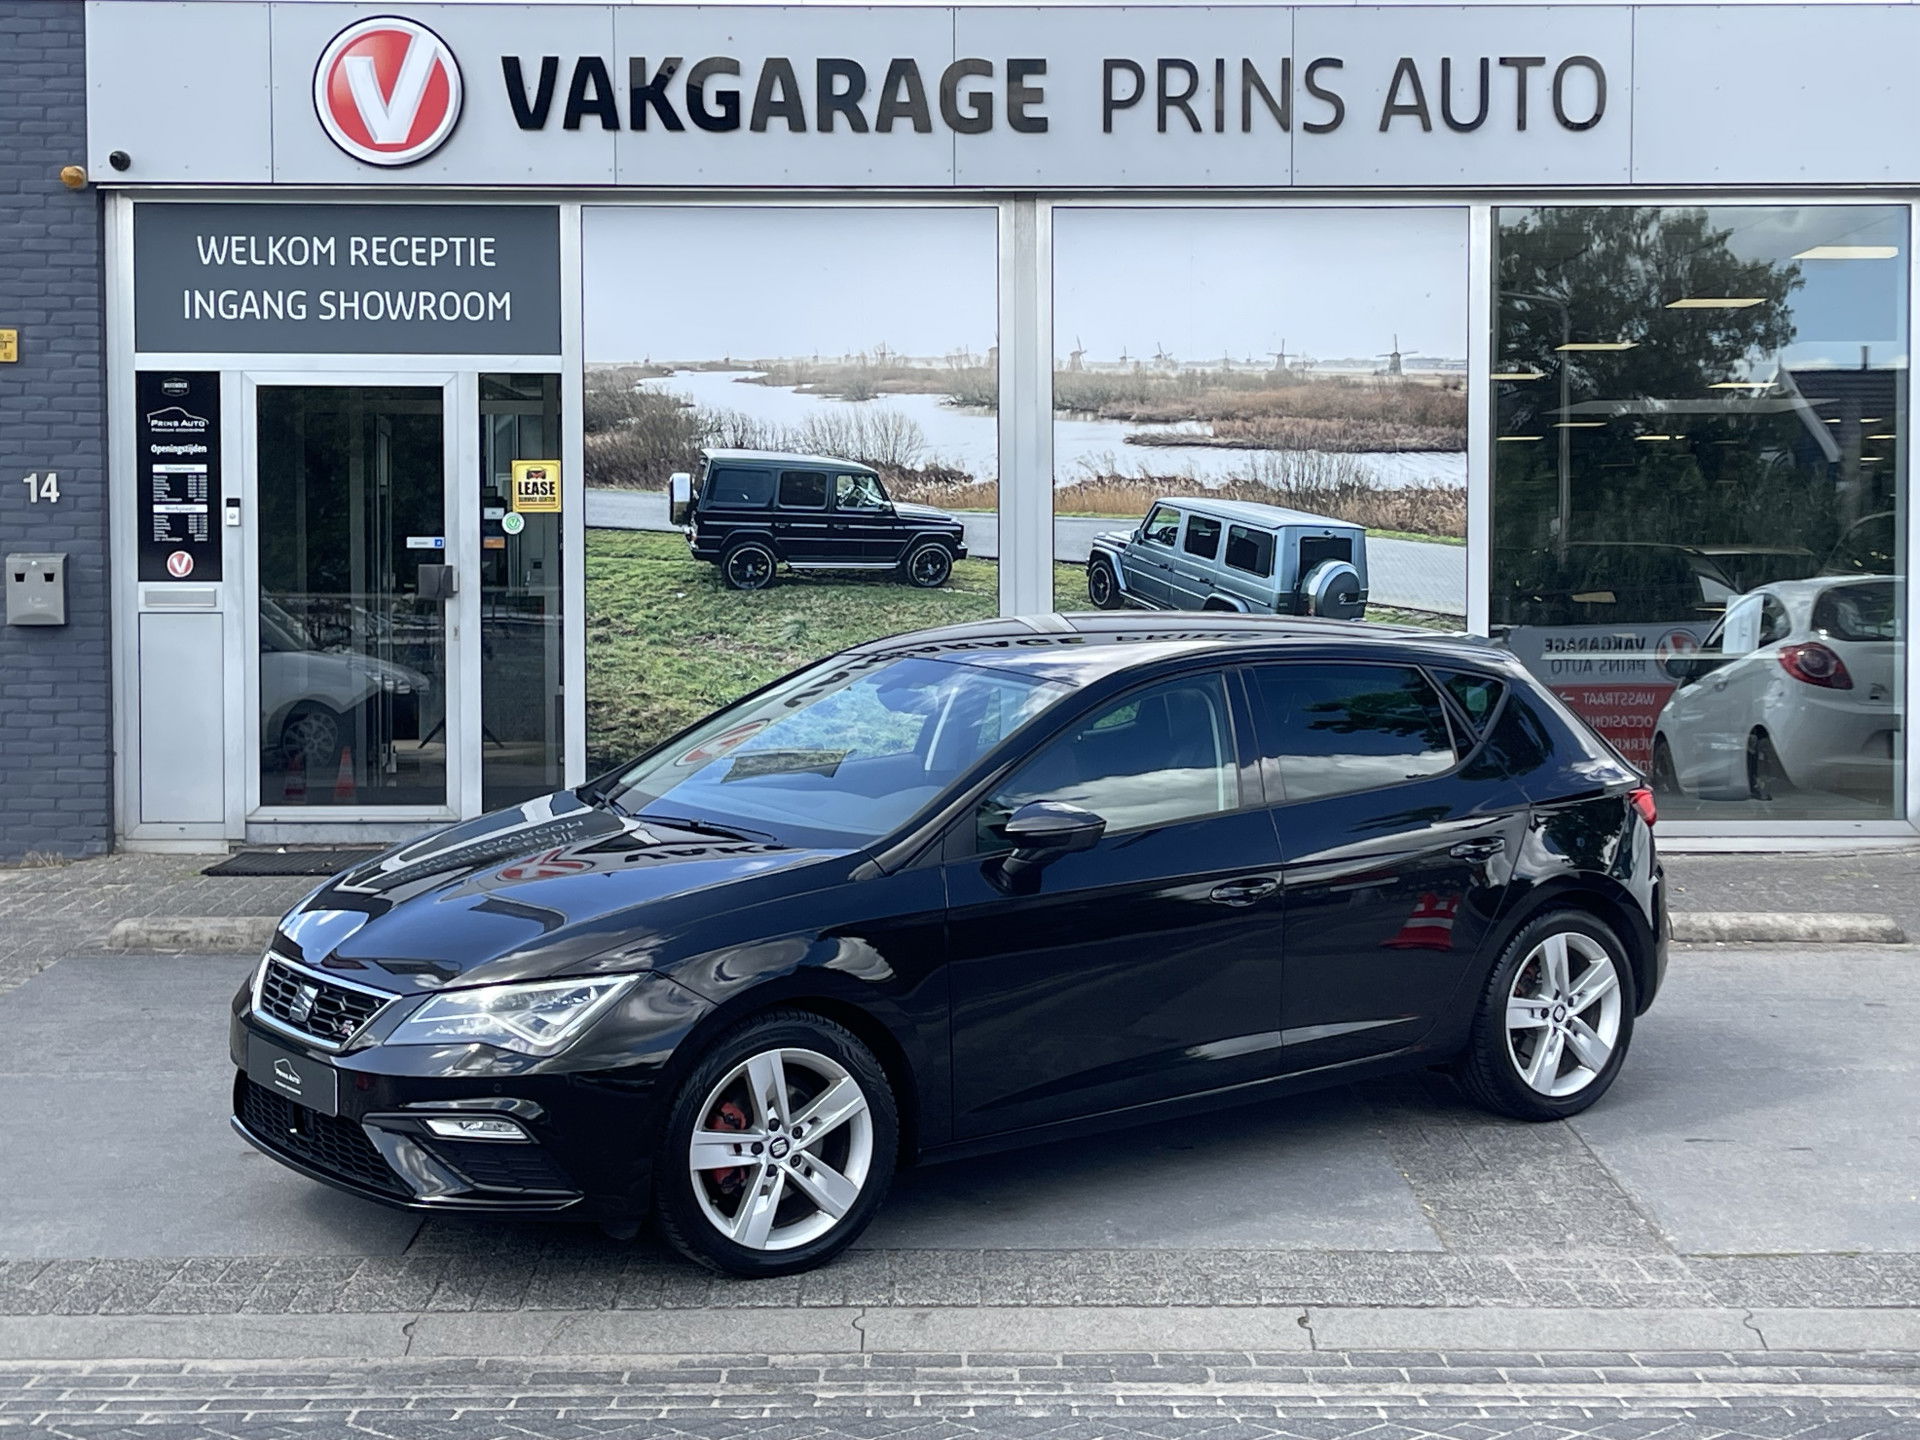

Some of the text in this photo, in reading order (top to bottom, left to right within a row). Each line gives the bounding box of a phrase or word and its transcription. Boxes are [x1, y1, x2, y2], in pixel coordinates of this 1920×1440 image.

[501, 55, 1607, 134] VAKGARAGE PRINS AUTO
[197, 235, 496, 267] WELKOM RECEPTIE
[184, 289, 511, 321] INGANG SHOWROOM
[150, 444, 208, 455] Openingstijden
[23, 472, 60, 503] 14
[518, 481, 556, 496] LEASE
